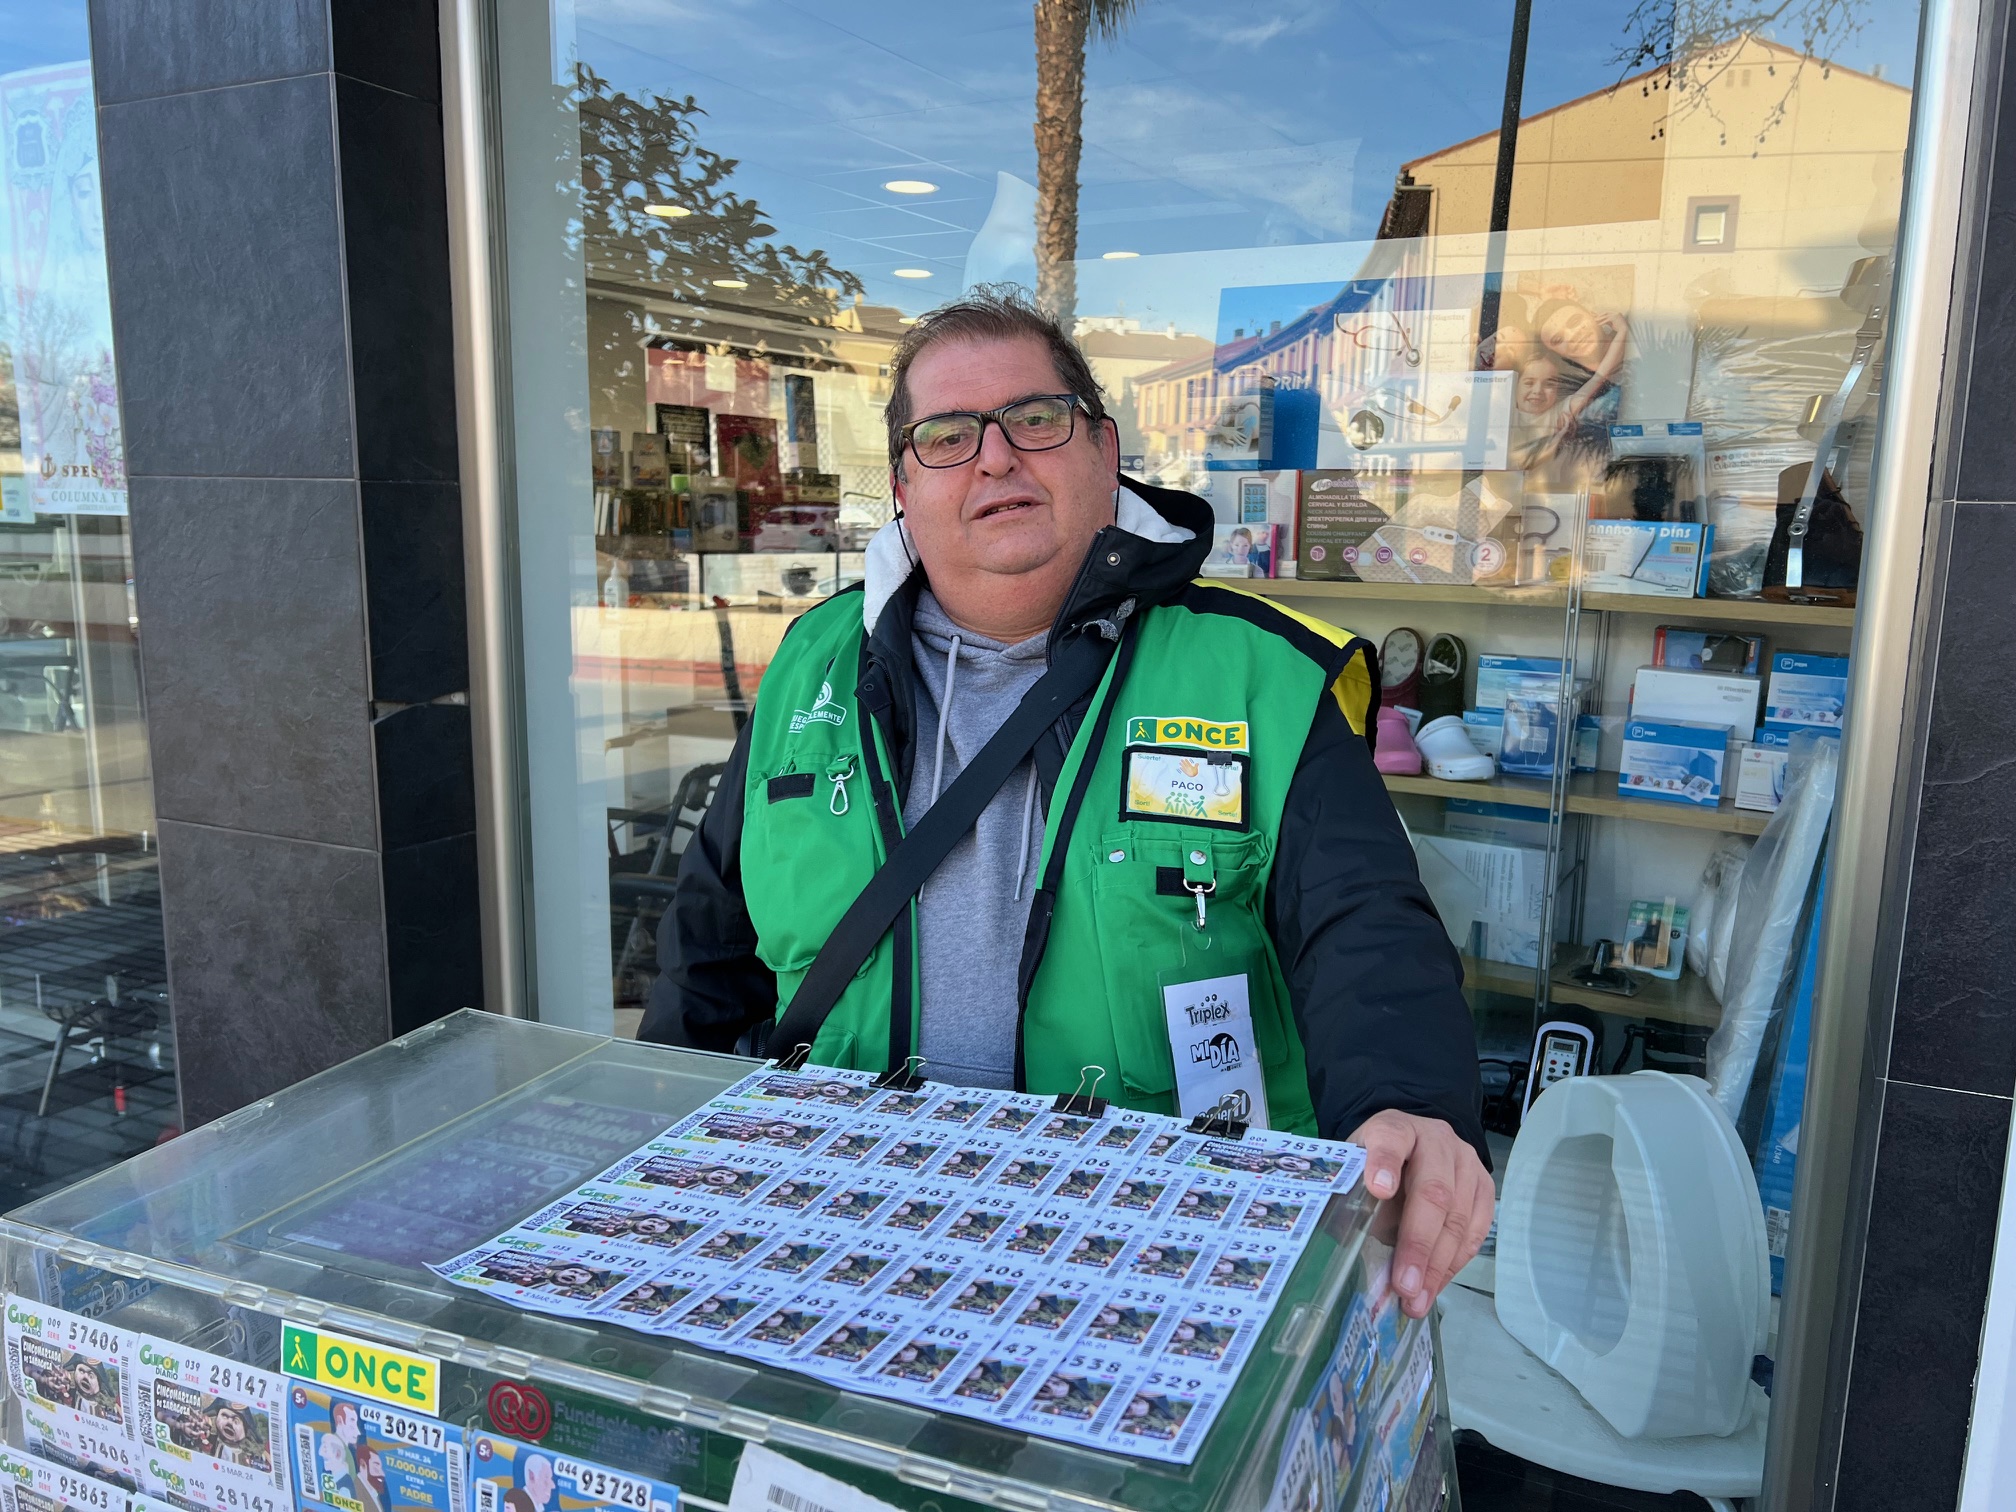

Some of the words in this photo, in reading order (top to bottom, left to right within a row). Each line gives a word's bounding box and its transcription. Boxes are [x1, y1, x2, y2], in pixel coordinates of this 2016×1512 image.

[1473, 376, 1508, 384] Riester
[62, 465, 98, 478] SPES
[51, 490, 107, 503] COLUMNA
[113, 491, 119, 503] Y
[1659, 526, 1691, 538] DÍAS
[1481, 548, 1491, 561] 2
[1163, 722, 1240, 745] ONCE
[1138, 753, 1161, 761] Suerte!
[1171, 780, 1204, 792] PACO
[1186, 1001, 1231, 1026] Triplex
[956, 1089, 992, 1099] 512
[1008, 1096, 1044, 1108] 863
[779, 1110, 839, 1123] 36870
[854, 1122, 891, 1132] 591
[910, 1130, 949, 1141] 512
[965, 1138, 1003, 1149] 863
[1280, 1139, 1348, 1157] 78512
[1023, 1147, 1061, 1159] 485
[720, 1153, 783, 1169] 36870
[799, 1167, 839, 1179] 591
[1134, 1166, 1172, 1178] 147
[1198, 1163, 1231, 1174] ONCE
[625, 1181, 654, 1190] ONCE
[858, 1177, 899, 1189] 512
[1196, 1175, 1237, 1189] 538
[916, 1186, 956, 1198] 863
[1262, 1187, 1306, 1199] 529
[653, 1200, 720, 1218] 36870
[976, 1196, 1017, 1209] 485
[736, 1217, 779, 1231] 591
[550, 1228, 579, 1238] ONCE
[798, 1228, 841, 1242] 512
[1159, 1229, 1205, 1243] 538
[613, 1242, 634, 1250] MAR.
[858, 1239, 902, 1252] 863
[1230, 1241, 1277, 1253] 529
[577, 1249, 648, 1268] 36870
[922, 1250, 964, 1265] 485
[465, 1275, 493, 1286] ONCE
[663, 1269, 709, 1283] 591
[729, 1281, 774, 1296] 512
[1117, 1288, 1167, 1303] 538
[529, 1292, 550, 1301] MAR.
[550, 1296, 561, 1304] 24
[858, 1308, 903, 1323] 485
[1192, 1302, 1242, 1317] 529
[8, 1304, 42, 1328] CUPÓN
[47, 1317, 61, 1328] 009
[69, 1321, 119, 1354] 57406
[22, 1325, 41, 1337] DIARIO
[47, 1331, 60, 1341] SERIE
[23, 1341, 61, 1363] CINCOMARZADA
[29, 1356, 52, 1371] ZARAGOZA
[1069, 1355, 1122, 1373] 538
[140, 1344, 179, 1373] CUPÓN
[185, 1359, 200, 1371] 039
[210, 1365, 267, 1399] 28147
[155, 1366, 178, 1380] DIARIO
[185, 1374, 199, 1384] SERIE
[325, 1346, 427, 1401] ONCE
[1148, 1372, 1201, 1392] 529
[156, 1385, 200, 1407] CINCOMARZADA
[36, 1398, 55, 1412] ONCE
[162, 1400, 191, 1416] ZARAGOZA
[86, 1418, 101, 1430] MAR.
[294, 1392, 305, 1405] 5€
[363, 1408, 380, 1421] 049
[384, 1415, 442, 1449] 30217
[554, 1401, 640, 1434] Fundación
[155, 1423, 167, 1439] 85
[57, 1428, 70, 1438] 010
[79, 1434, 129, 1465] 57406
[167, 1445, 191, 1460] ONCE
[404, 1449, 421, 1461] MAR.
[421, 1456, 431, 1464] 24
[227, 1468, 245, 1480] MAR.
[245, 1473, 253, 1481] 24
[385, 1456, 438, 1480] 17.000.000
[0, 1454, 33, 1480] CUPÓN
[38, 1470, 51, 1480] 019
[60, 1476, 107, 1509] 95863
[405, 1475, 424, 1485] EXTRA
[479, 1446, 490, 1457] 5€
[557, 1463, 577, 1476] 044
[582, 1469, 647, 1508] 93728
[39, 1482, 51, 1492] SERIE
[189, 1478, 204, 1489] 040
[215, 1484, 273, 1512] 28147
[193, 1489, 207, 1500] SERIE
[400, 1486, 433, 1504] PADRE
[334, 1494, 362, 1510] ONCE
